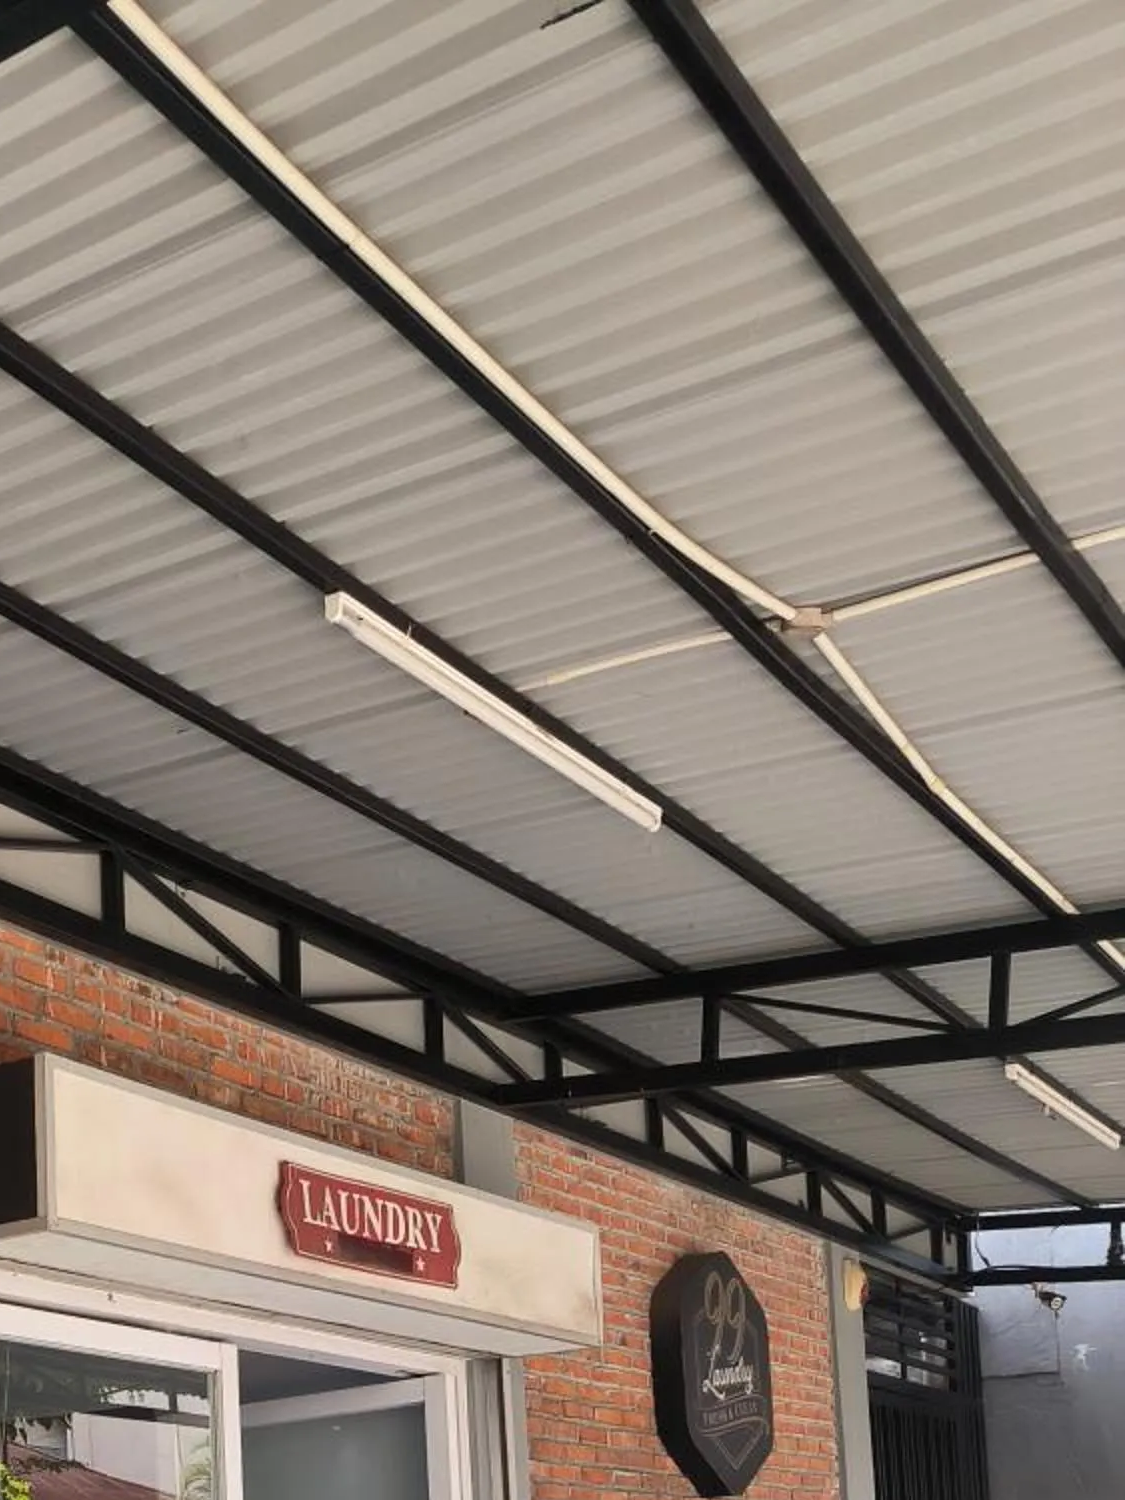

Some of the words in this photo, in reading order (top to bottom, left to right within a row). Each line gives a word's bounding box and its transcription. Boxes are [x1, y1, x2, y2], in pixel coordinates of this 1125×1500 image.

[299, 1179, 442, 1253] LAUNDRY
[704, 1271, 746, 1363] 99
[701, 1345, 755, 1400] Laundry
